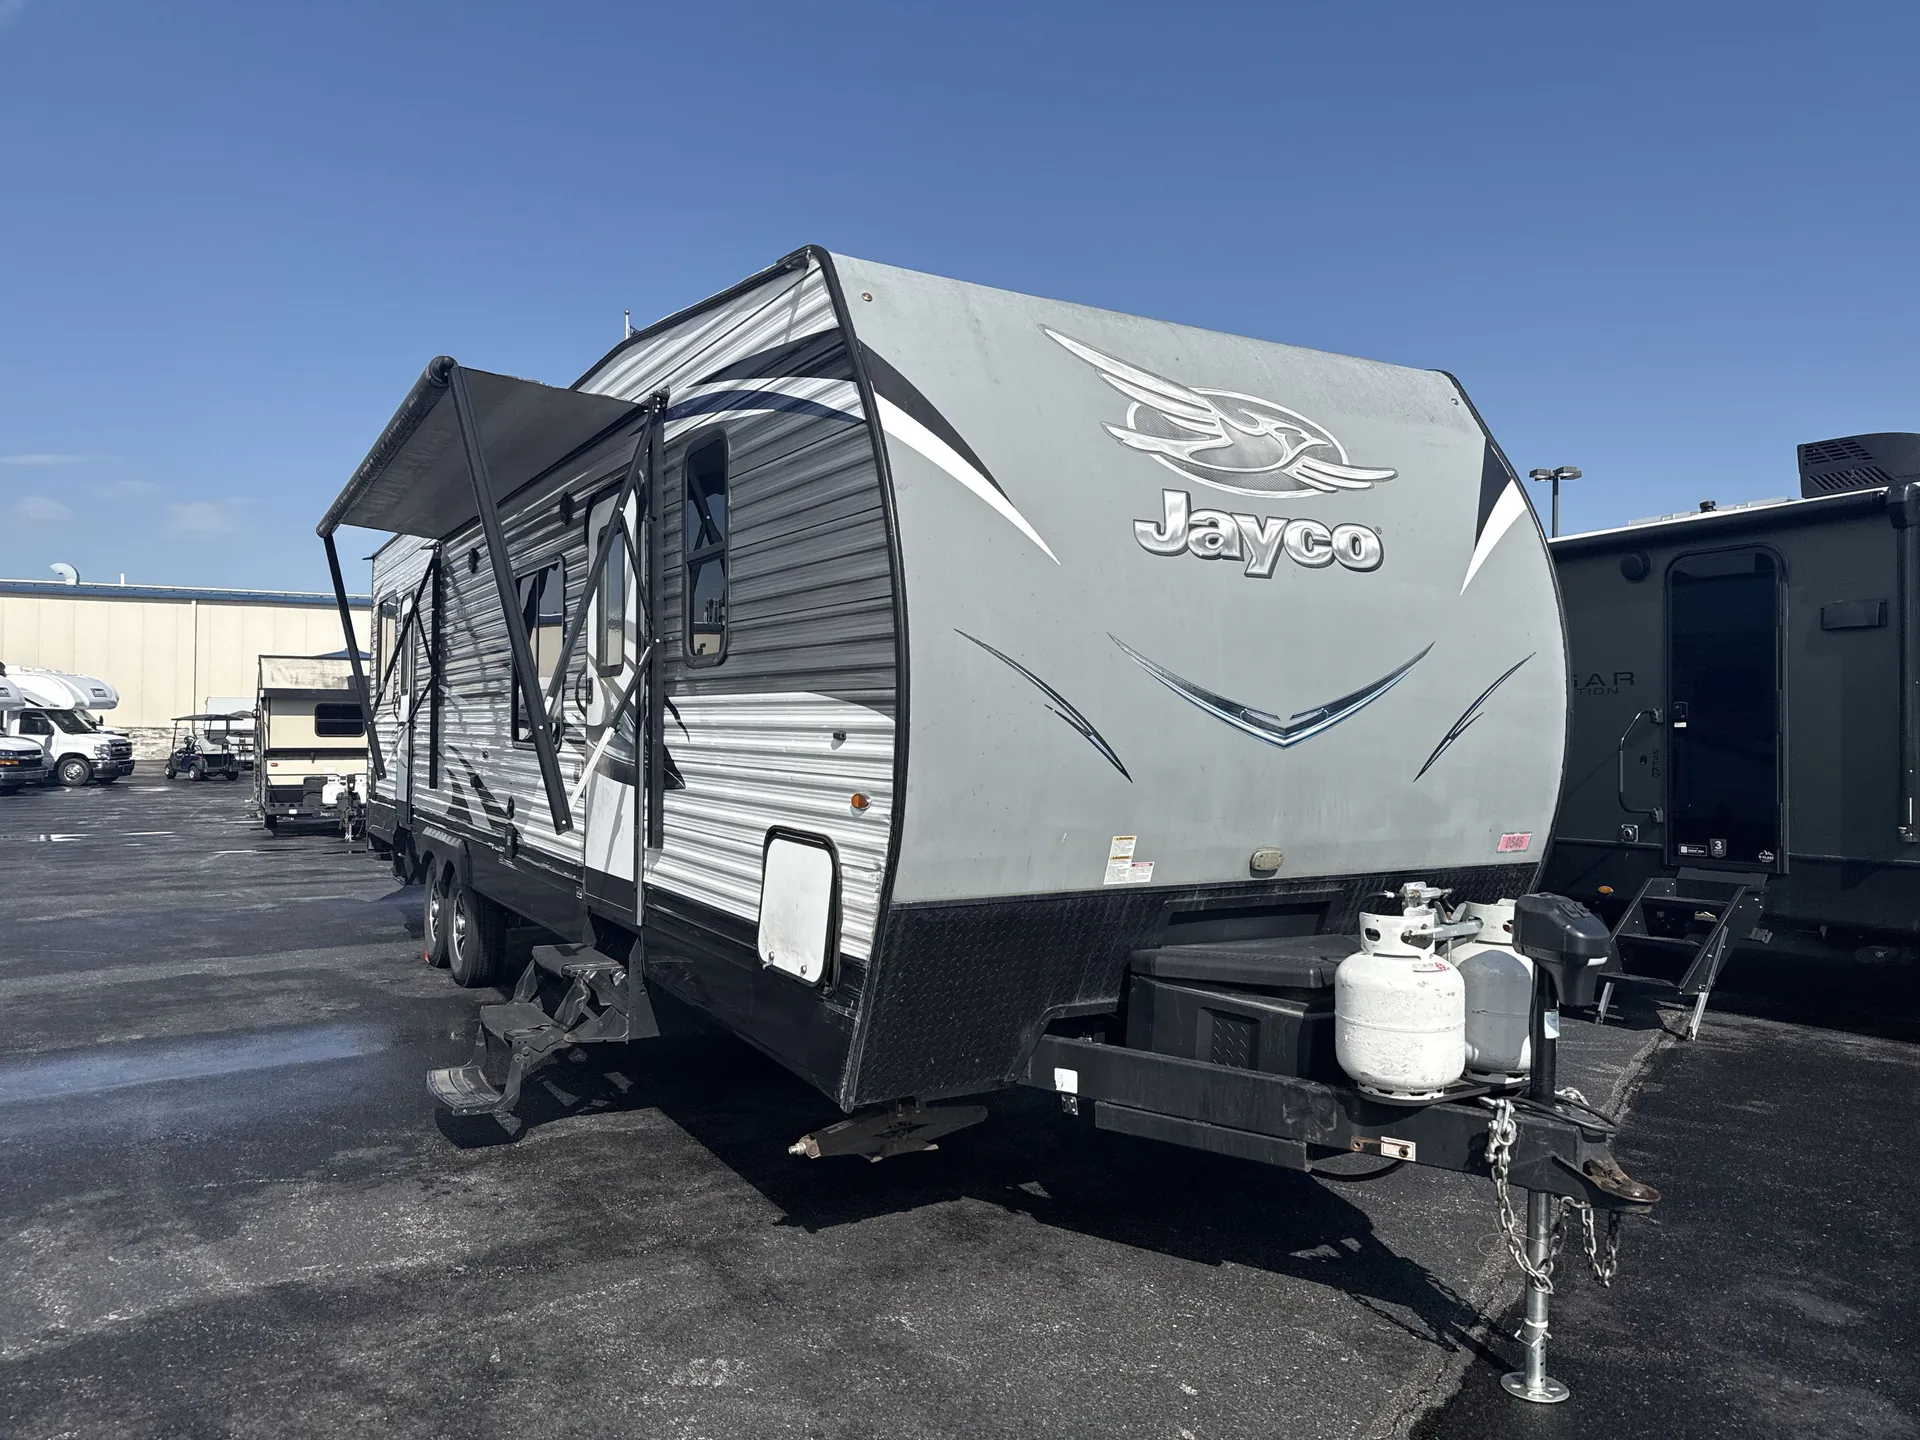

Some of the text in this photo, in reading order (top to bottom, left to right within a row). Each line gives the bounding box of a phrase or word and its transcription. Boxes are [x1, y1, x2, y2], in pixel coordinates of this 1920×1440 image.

[1133, 489, 1385, 579] Jayco
[1573, 672, 1635, 687] AR
[1715, 841, 1722, 849] 3
